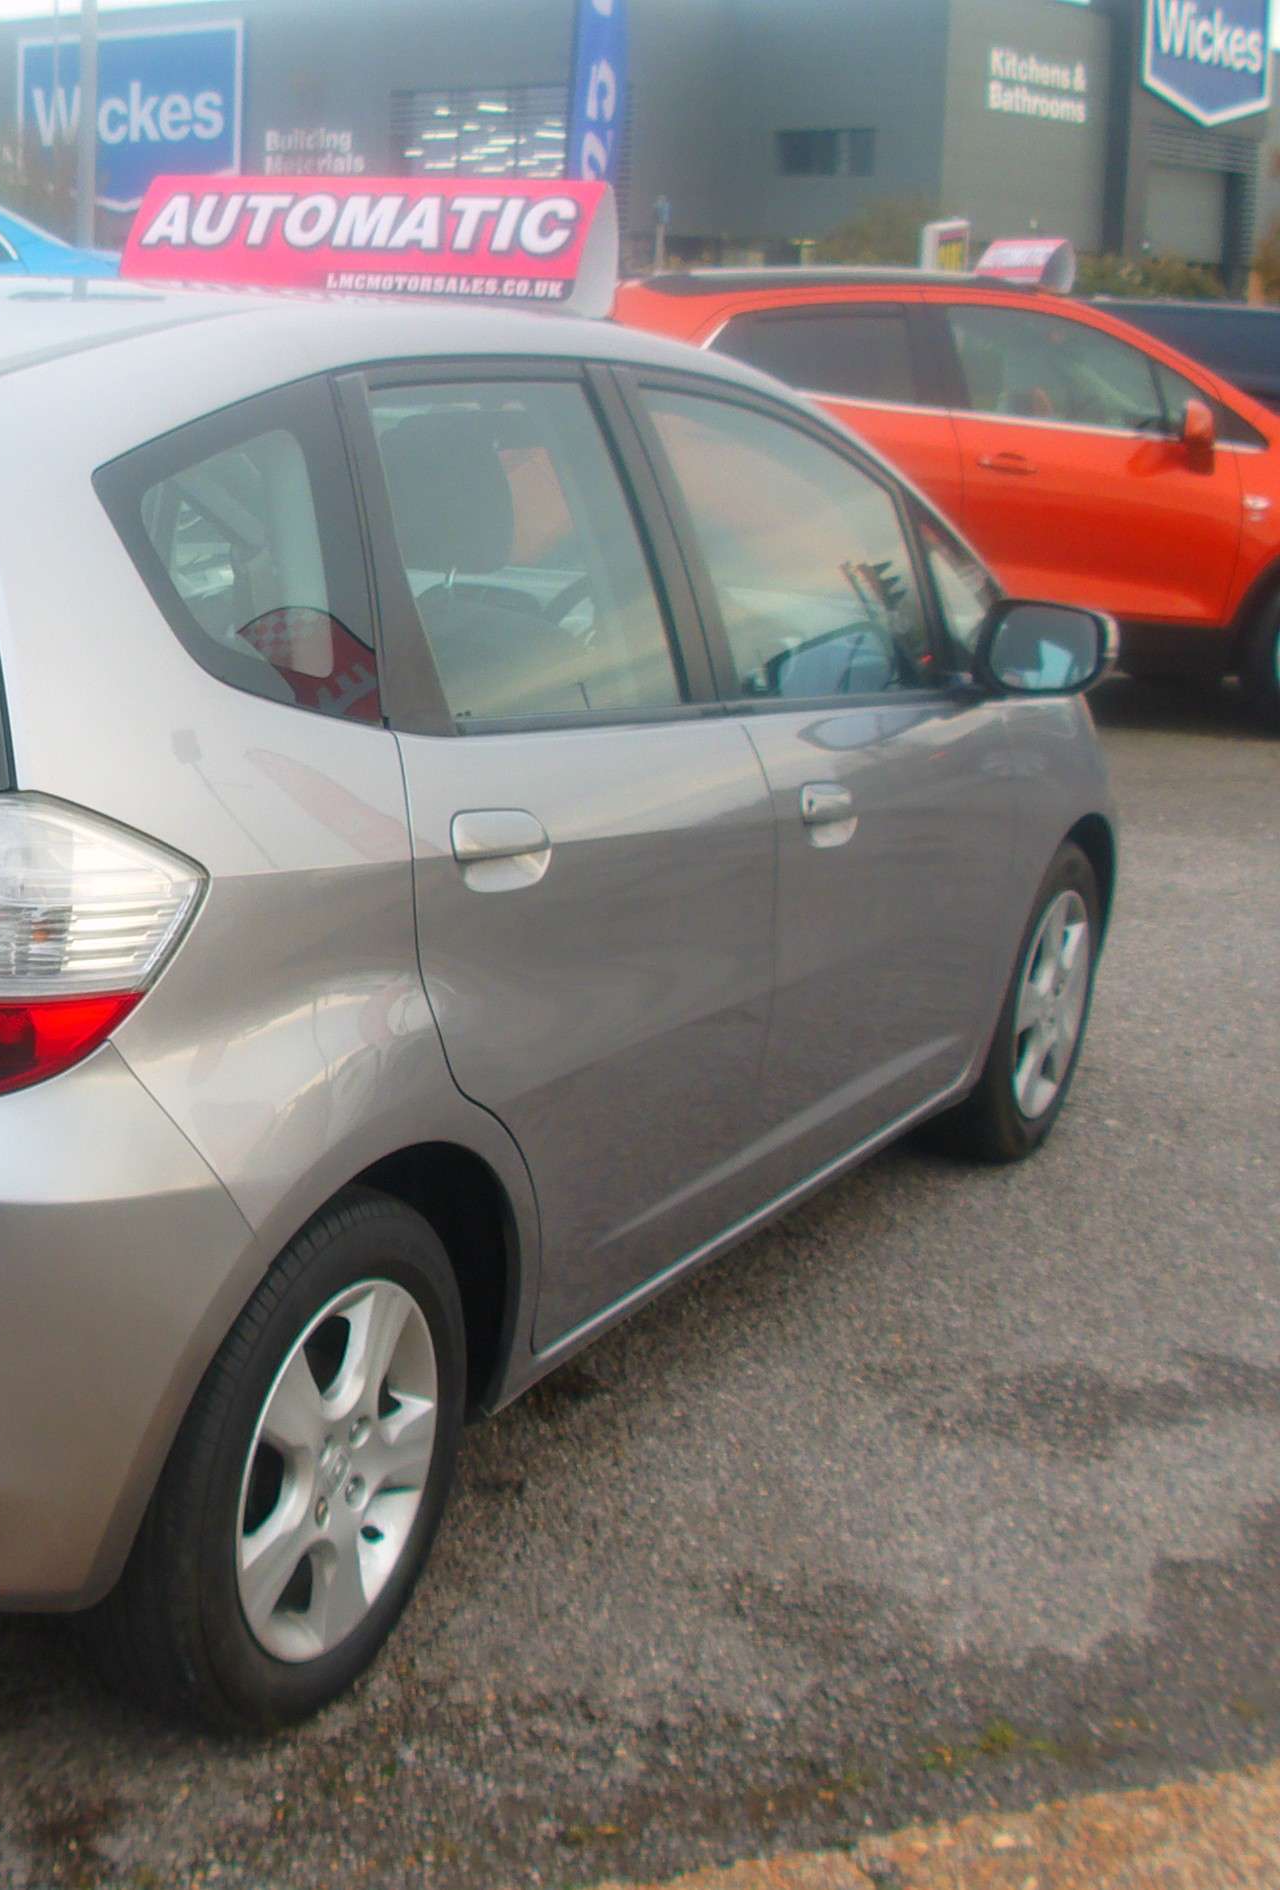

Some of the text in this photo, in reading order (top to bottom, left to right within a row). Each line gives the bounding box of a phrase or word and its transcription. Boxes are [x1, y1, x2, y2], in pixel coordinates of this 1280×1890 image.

[1154, 0, 1264, 74] Wickes
[990, 47, 1086, 92] Kitchens &
[32, 80, 224, 147] Wckes
[988, 80, 1087, 123] Bathrooms
[140, 194, 578, 256] AUTOMATIC
[326, 271, 565, 299] LMCMOTORSALES.CO.UK
